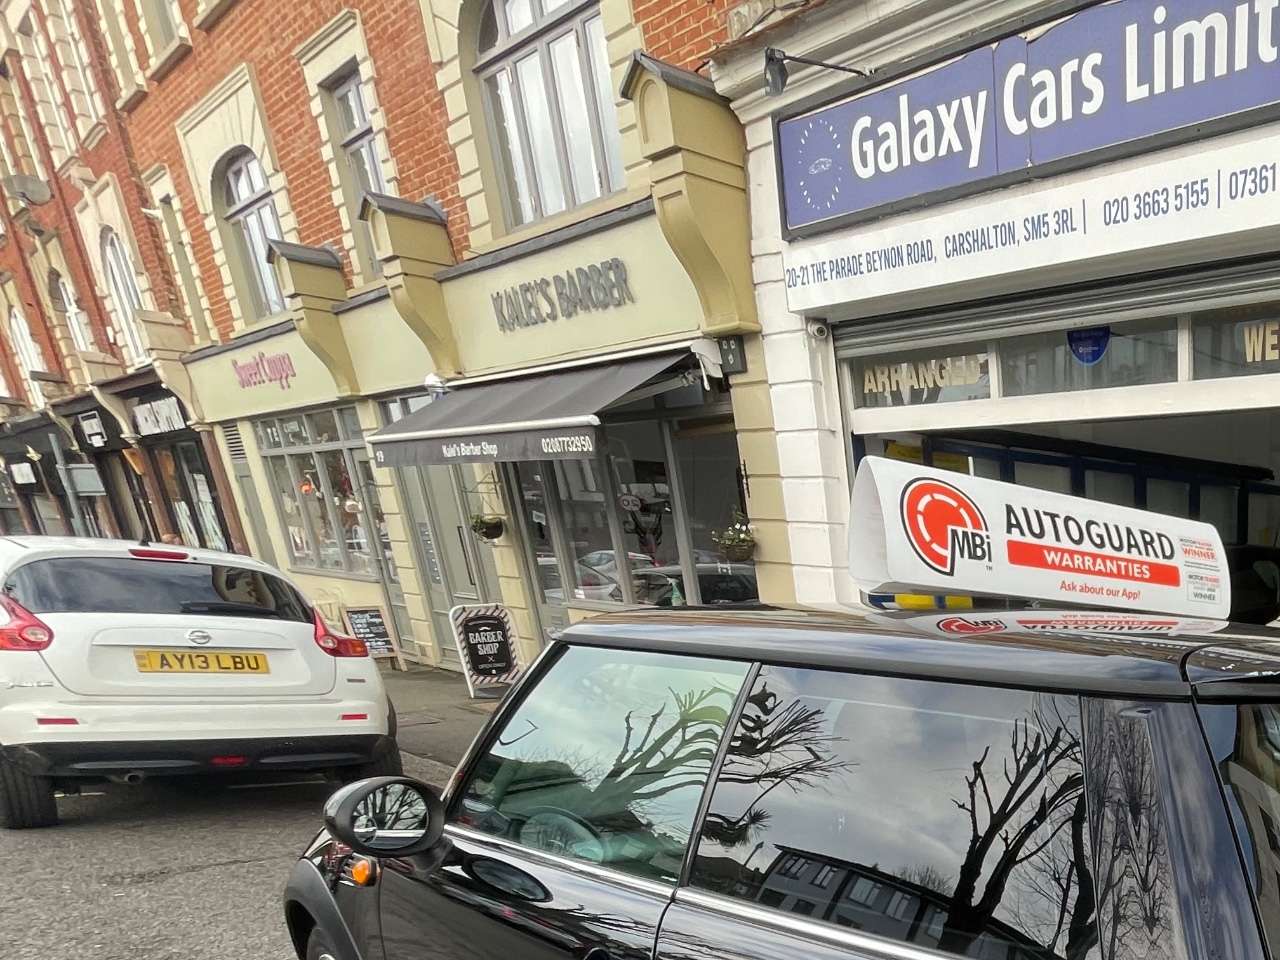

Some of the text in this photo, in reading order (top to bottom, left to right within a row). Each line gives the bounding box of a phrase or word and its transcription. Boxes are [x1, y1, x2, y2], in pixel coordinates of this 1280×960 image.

[851, 90, 988, 178] Galaxy
[1003, 52, 1103, 136] Cars
[1103, 196, 1129, 226] 020
[1134, 188, 1169, 220] 3663
[1174, 178, 1209, 211] 5155
[1229, 163, 1276, 200] 07361
[785, 206, 1078, 288] 20-21 THE PARADE BEYNON ROAD, CARSHALTON, SM5 3RL
[553, 257, 636, 319] BARBER
[1005, 503, 1175, 560] AUTOGUARD
[1043, 549, 1151, 580] WARRANTIES
[1184, 547, 1216, 560] WINNER
[1059, 580, 1141, 600] Ask about our App!
[469, 630, 504, 643] BARBER
[477, 643, 499, 655] SHOP
[160, 654, 260, 671] AY13 LBU
